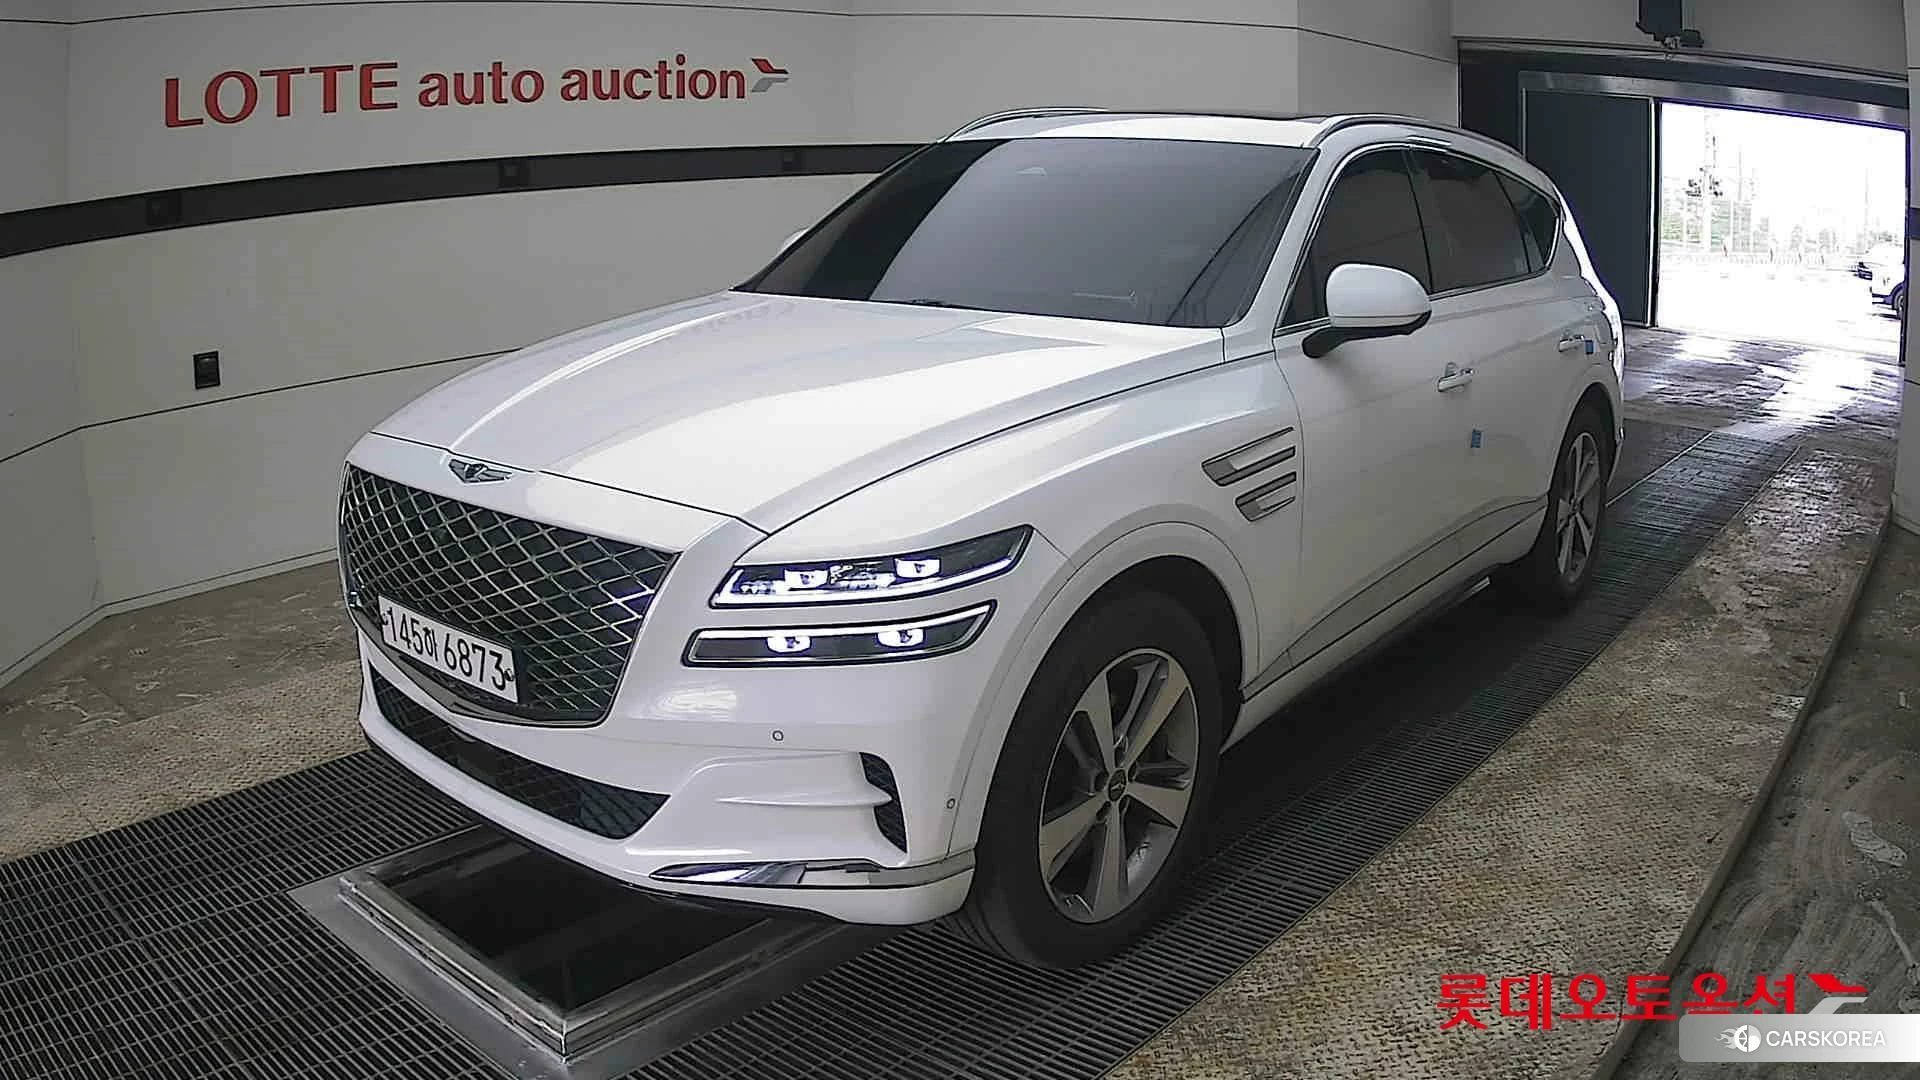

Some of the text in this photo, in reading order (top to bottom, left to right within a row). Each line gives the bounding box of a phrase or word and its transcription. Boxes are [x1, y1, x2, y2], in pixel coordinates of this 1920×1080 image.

[164, 53, 747, 128] LOTTE auto auction
[444, 633, 506, 691] 6873
